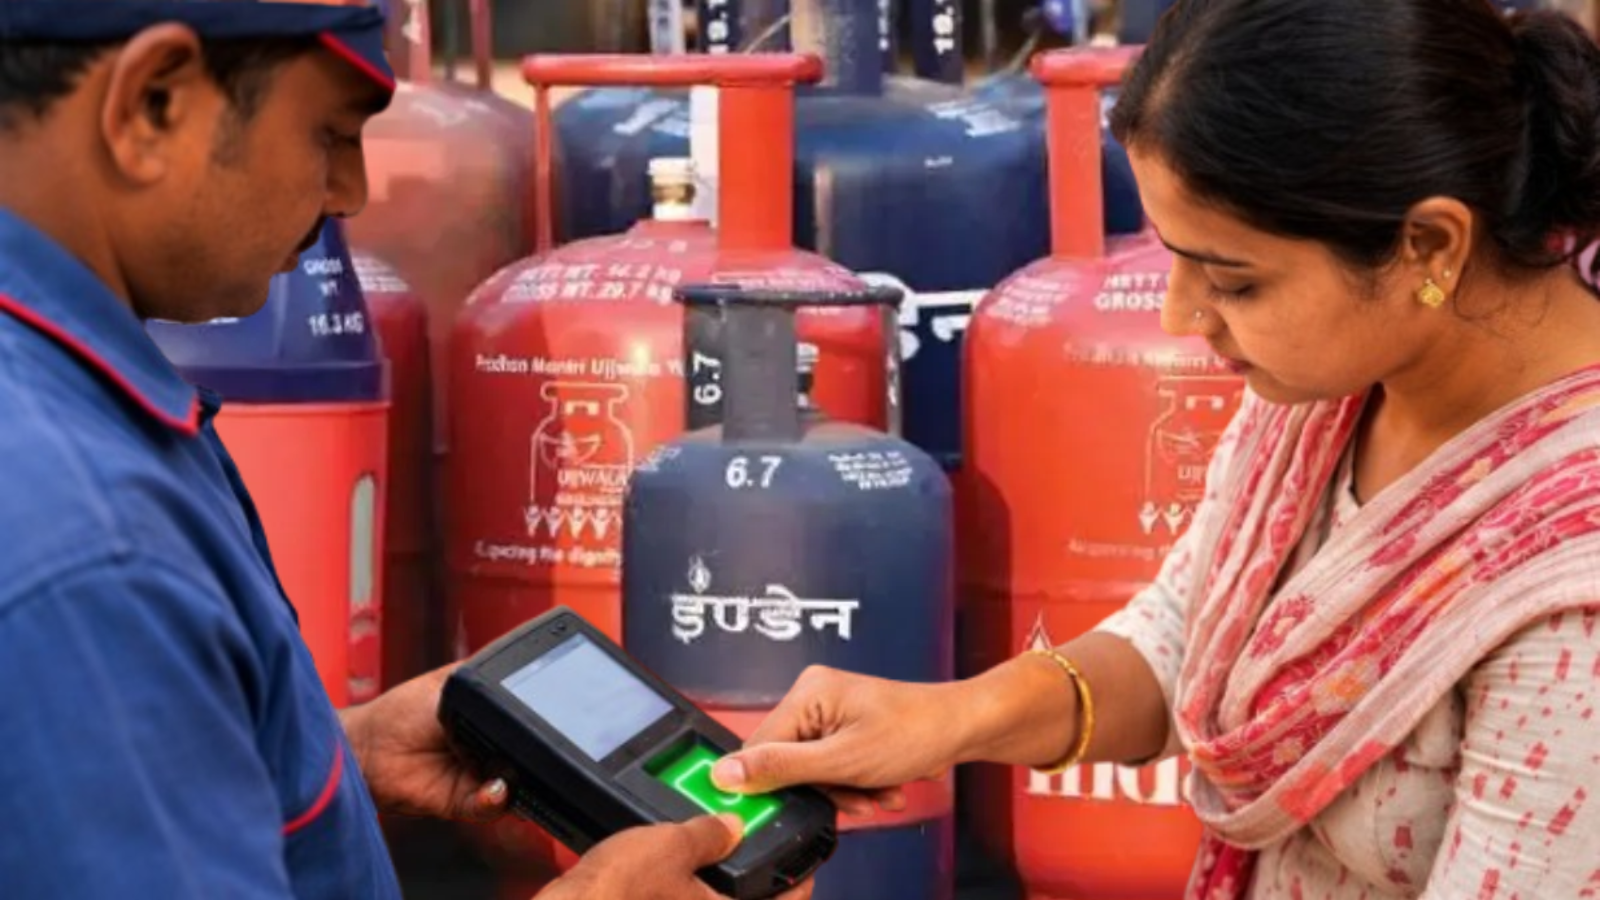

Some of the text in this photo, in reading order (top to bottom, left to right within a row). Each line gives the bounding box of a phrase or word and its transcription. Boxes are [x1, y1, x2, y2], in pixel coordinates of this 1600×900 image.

[693, 353, 723, 406] 6.7
[725, 456, 782, 488] 6.7
[670, 584, 860, 644] इण्डेन
